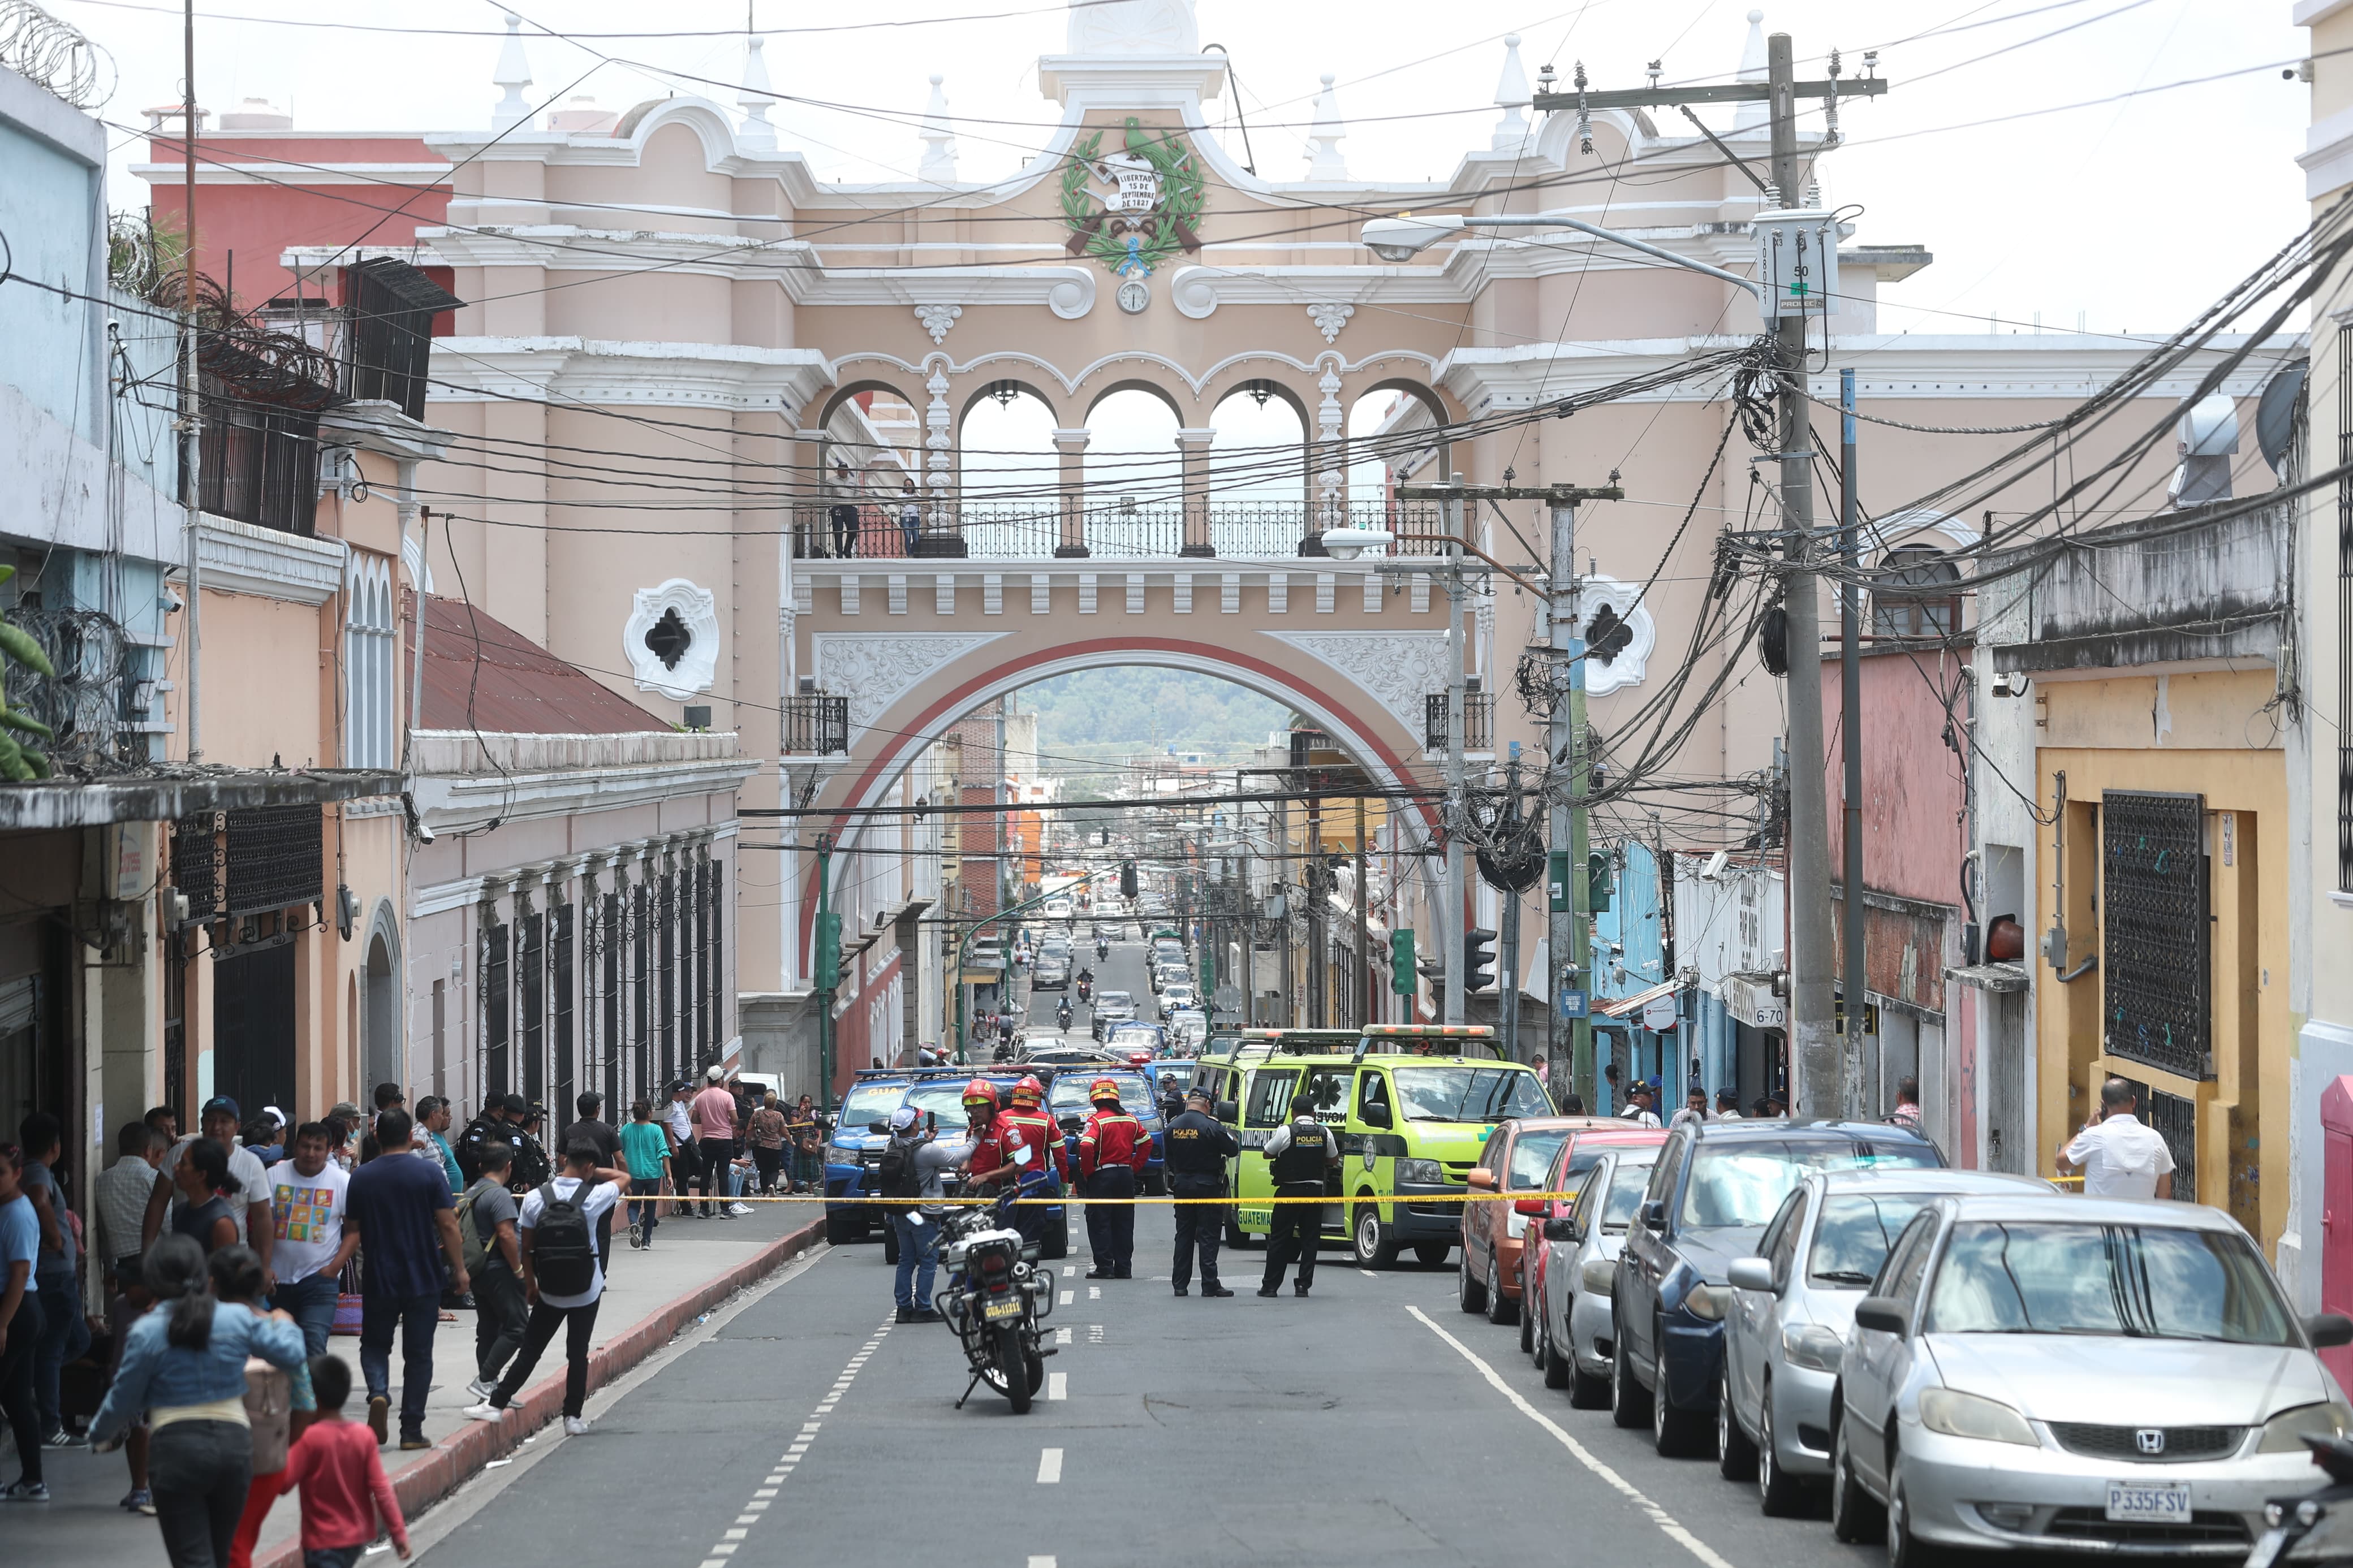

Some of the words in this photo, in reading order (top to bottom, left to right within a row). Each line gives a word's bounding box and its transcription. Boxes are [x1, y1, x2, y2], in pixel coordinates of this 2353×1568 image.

[1121, 191, 1155, 200] SEPTIEMBRE
[1794, 266, 1809, 277] 50
[1756, 1009, 1783, 1023] 6-70
[986, 1302, 1020, 1317] GUA-11211
[2110, 1490, 2187, 1512] P335FSV
